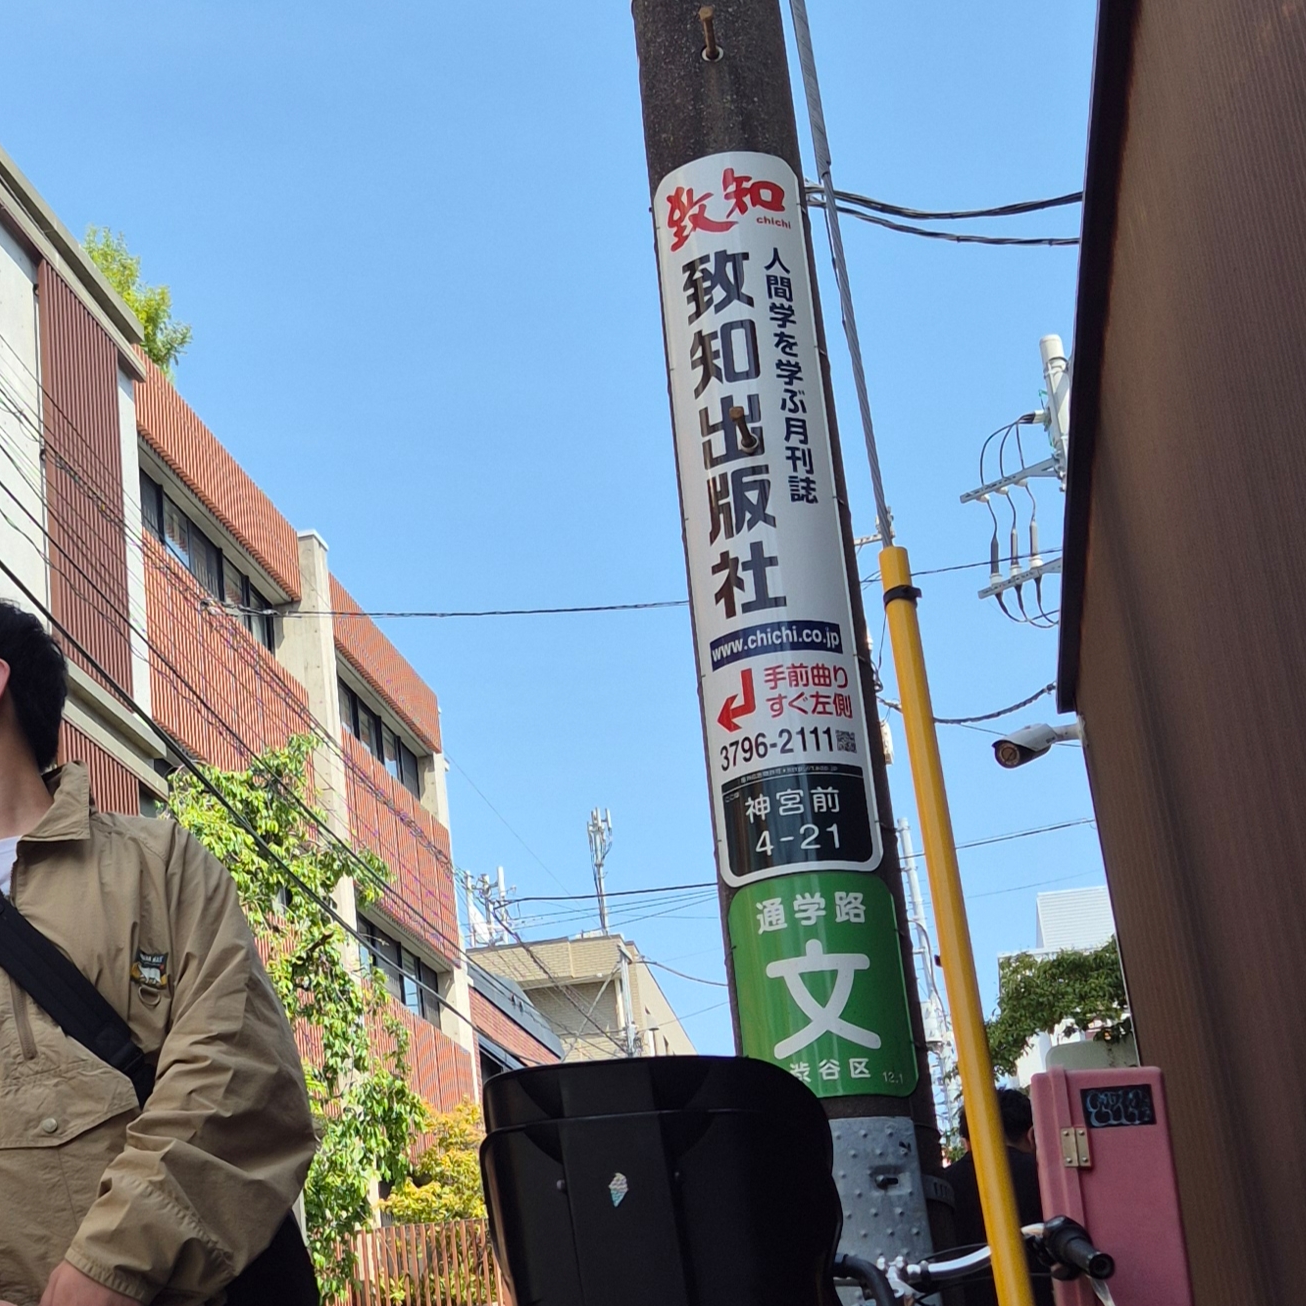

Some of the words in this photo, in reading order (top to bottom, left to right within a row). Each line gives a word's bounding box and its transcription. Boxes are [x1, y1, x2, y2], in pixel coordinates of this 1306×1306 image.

[666, 167, 785, 252] 致知
[756, 216, 791, 229] chichi
[764, 248, 819, 505] 人間学を学ぶ月刊誌
[682, 249, 787, 619] 致知出版社
[712, 625, 840, 662] www.chichi.co.jp
[763, 663, 849, 690] 手前曲り
[765, 691, 853, 719] すぐ左側
[720, 726, 834, 772] 3796-2111
[745, 786, 840, 824] 神宮前
[755, 823, 840, 856] 4-21
[755, 891, 866, 935] 通学路
[765, 938, 882, 1061] 文
[790, 1058, 871, 1082] 渋谷区
